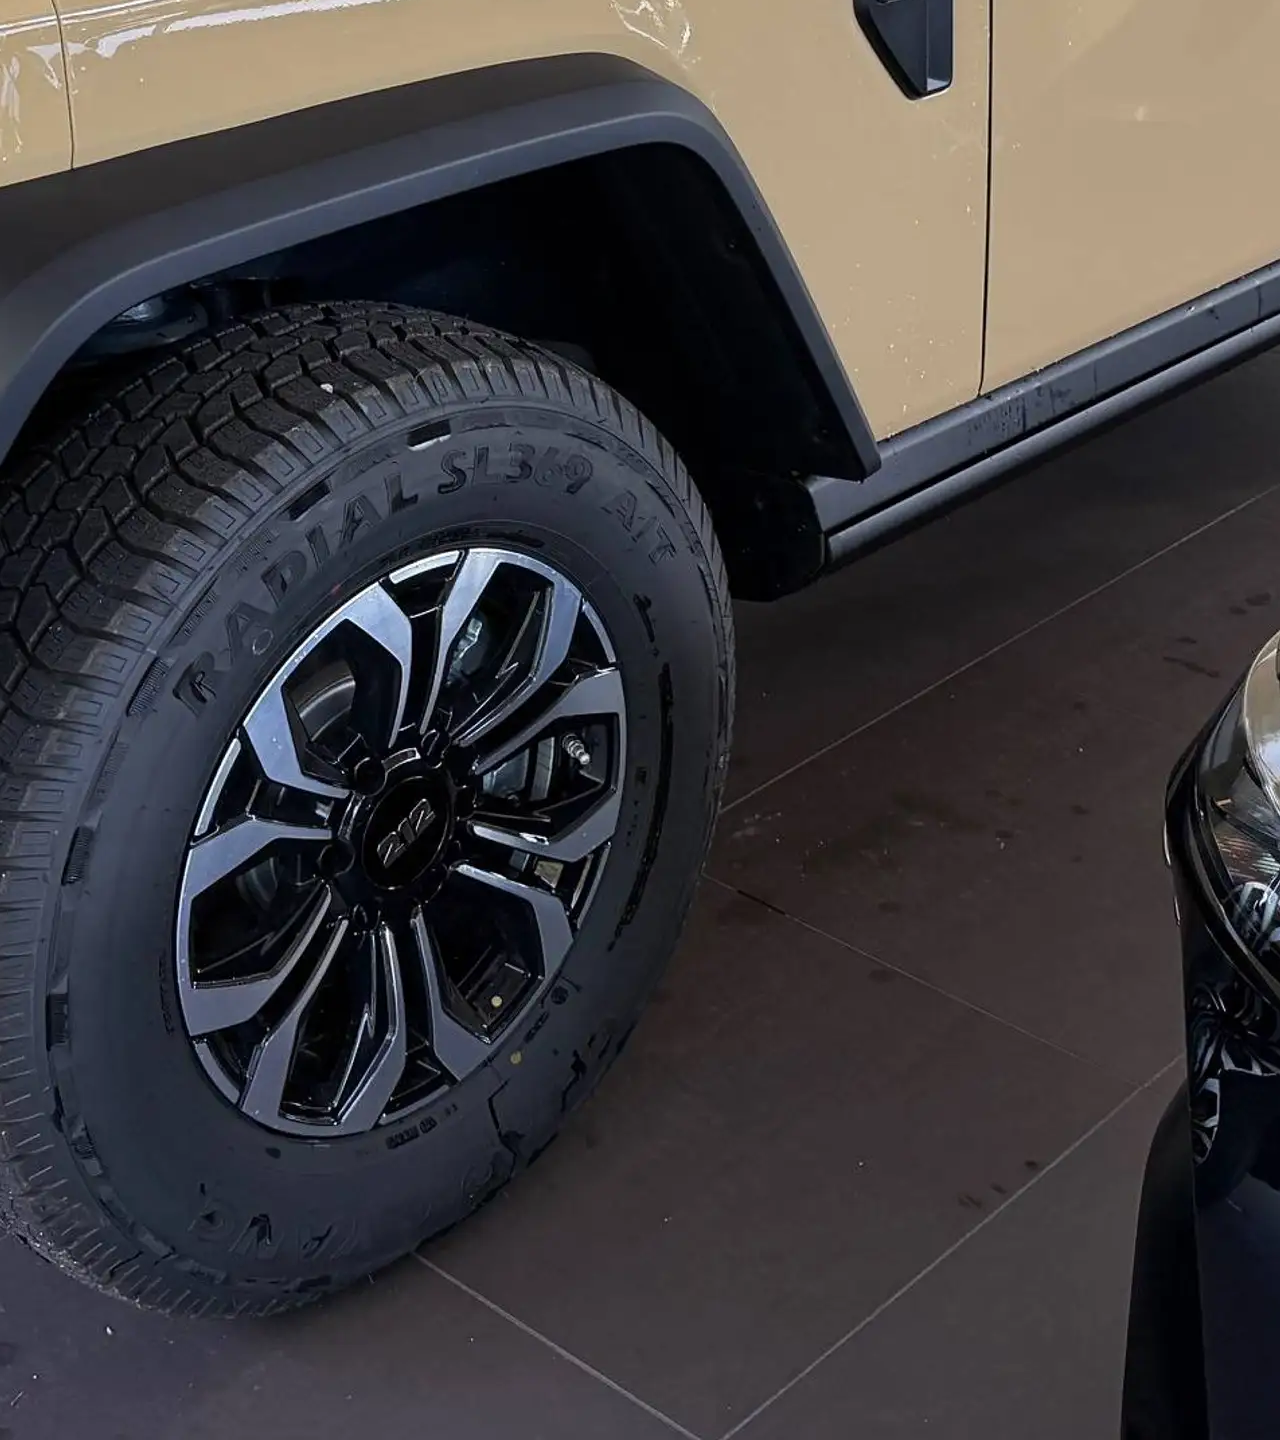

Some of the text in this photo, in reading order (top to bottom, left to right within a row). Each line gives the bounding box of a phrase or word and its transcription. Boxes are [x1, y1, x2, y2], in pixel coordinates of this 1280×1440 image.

[173, 472, 419, 720] RADIAL
[436, 442, 593, 496] SL369
[376, 798, 437, 869] 212
